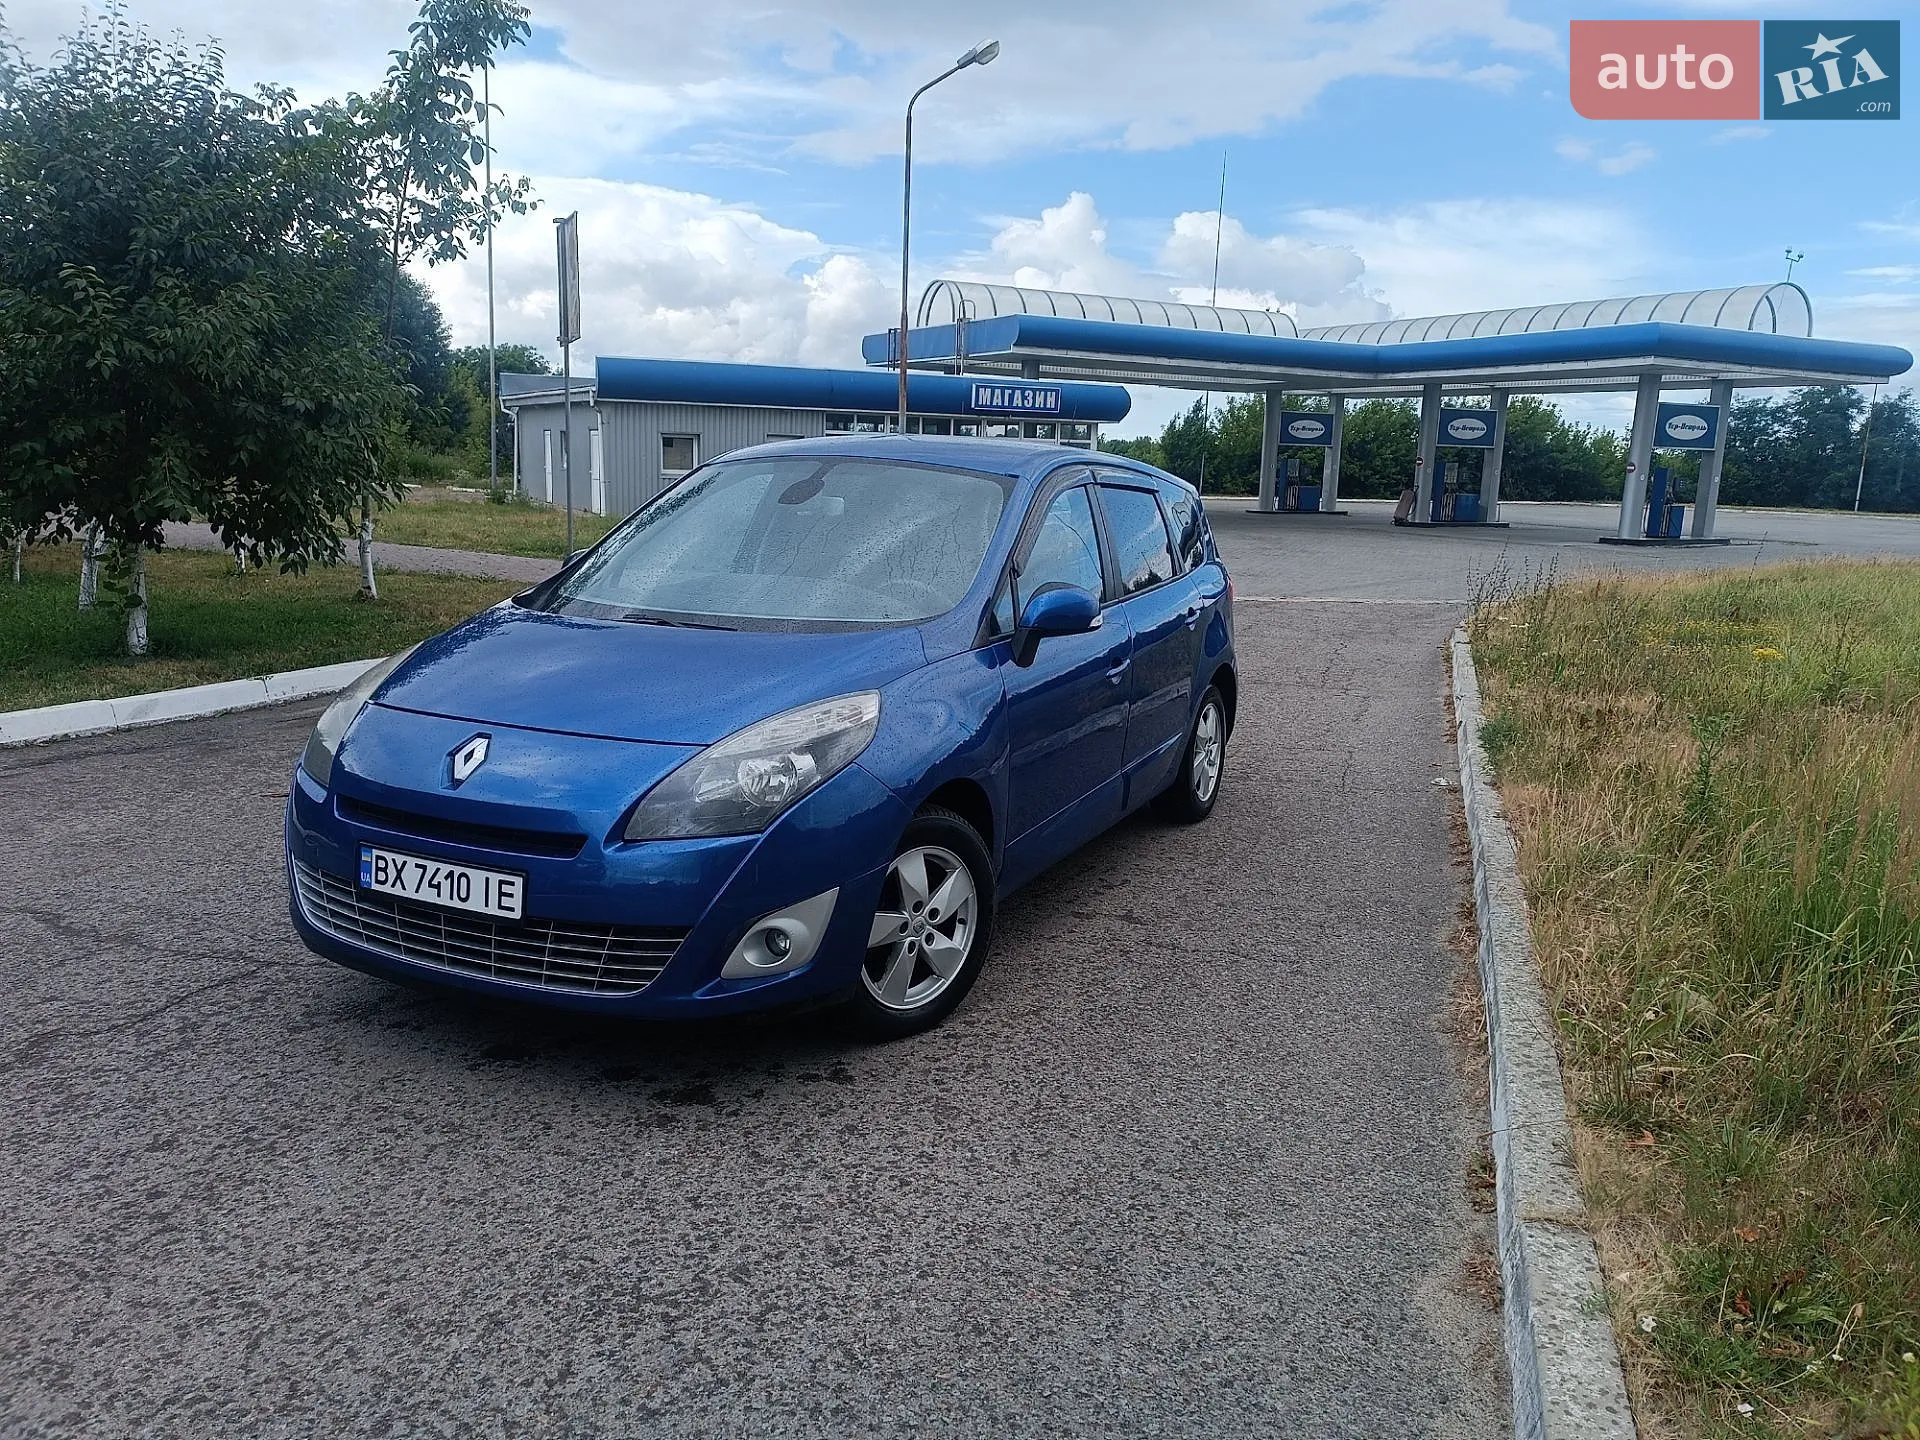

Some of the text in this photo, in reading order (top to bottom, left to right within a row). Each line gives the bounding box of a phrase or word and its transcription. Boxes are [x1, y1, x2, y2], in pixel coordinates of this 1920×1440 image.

[978, 387, 1056, 409] МАГАЗИН
[360, 871, 371, 883] UA
[374, 854, 516, 913] BX 7410 IE
